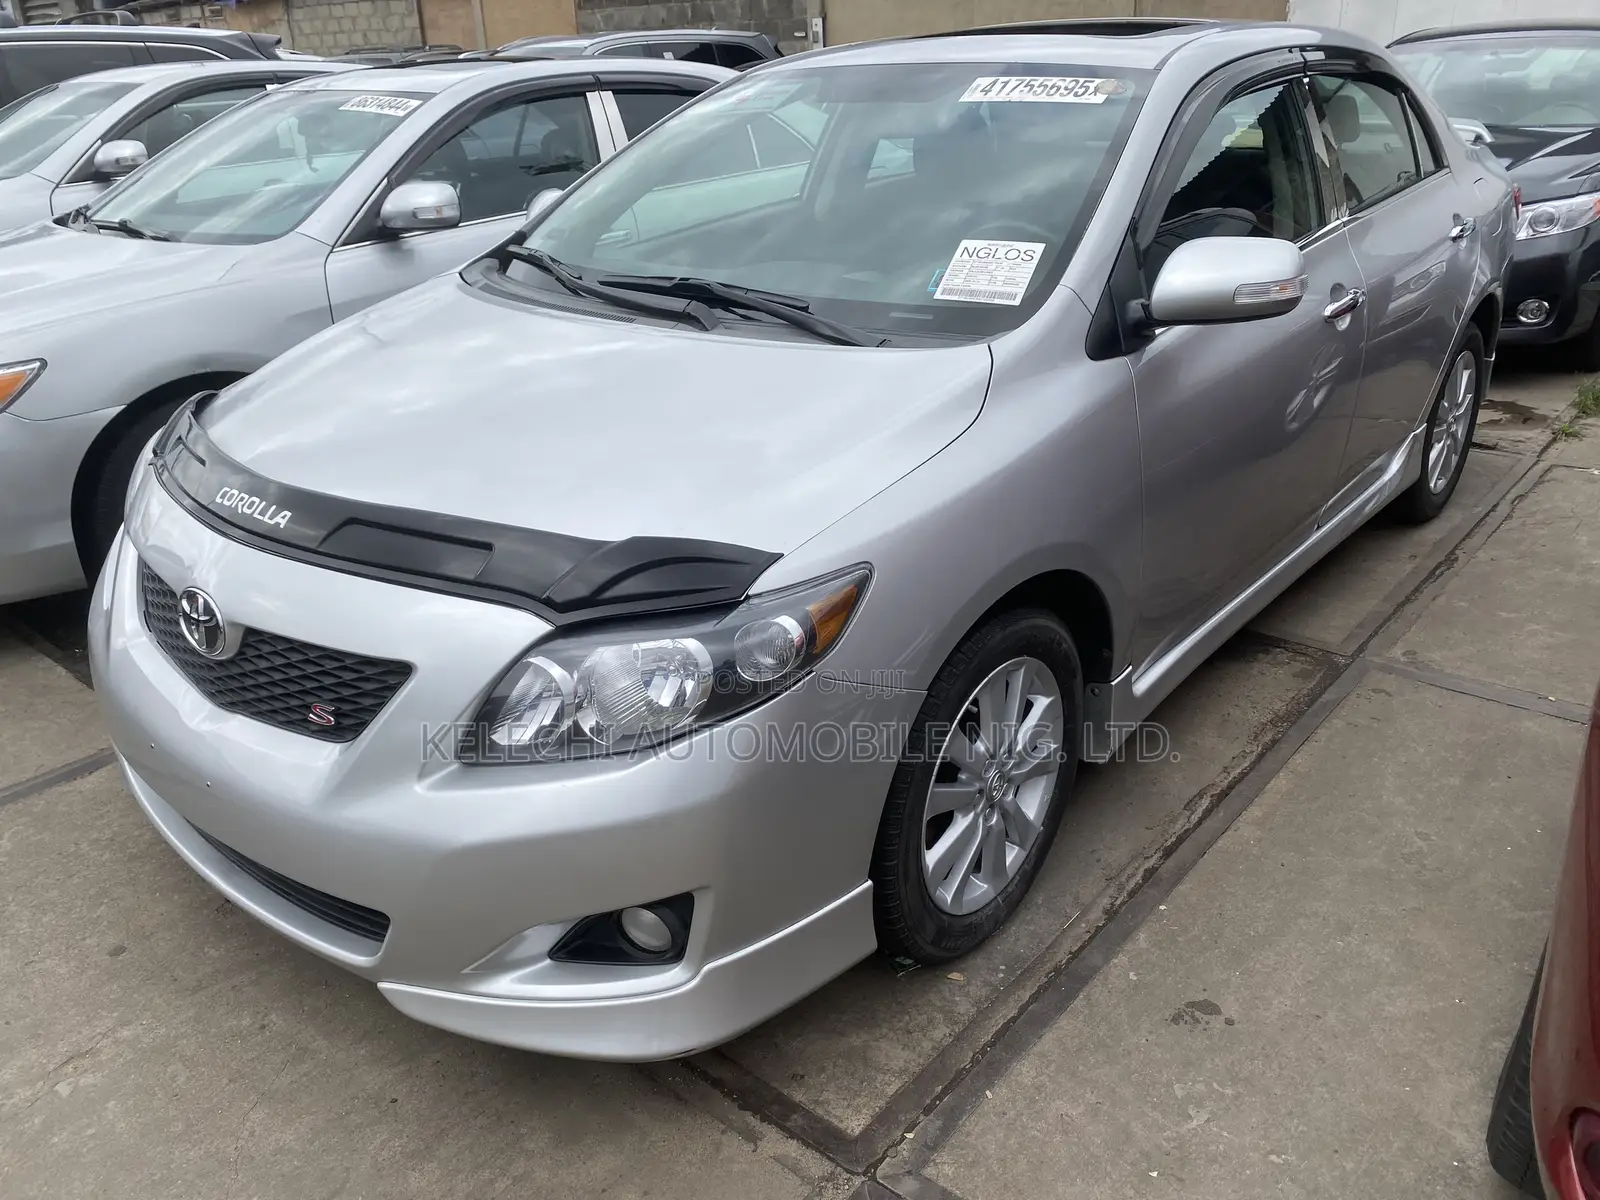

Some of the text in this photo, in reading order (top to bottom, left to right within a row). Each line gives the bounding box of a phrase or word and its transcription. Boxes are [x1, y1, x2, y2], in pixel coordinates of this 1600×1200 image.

[960, 246, 1036, 262] NGLOS
[215, 486, 292, 528] COROLLA
[307, 703, 335, 725] S
